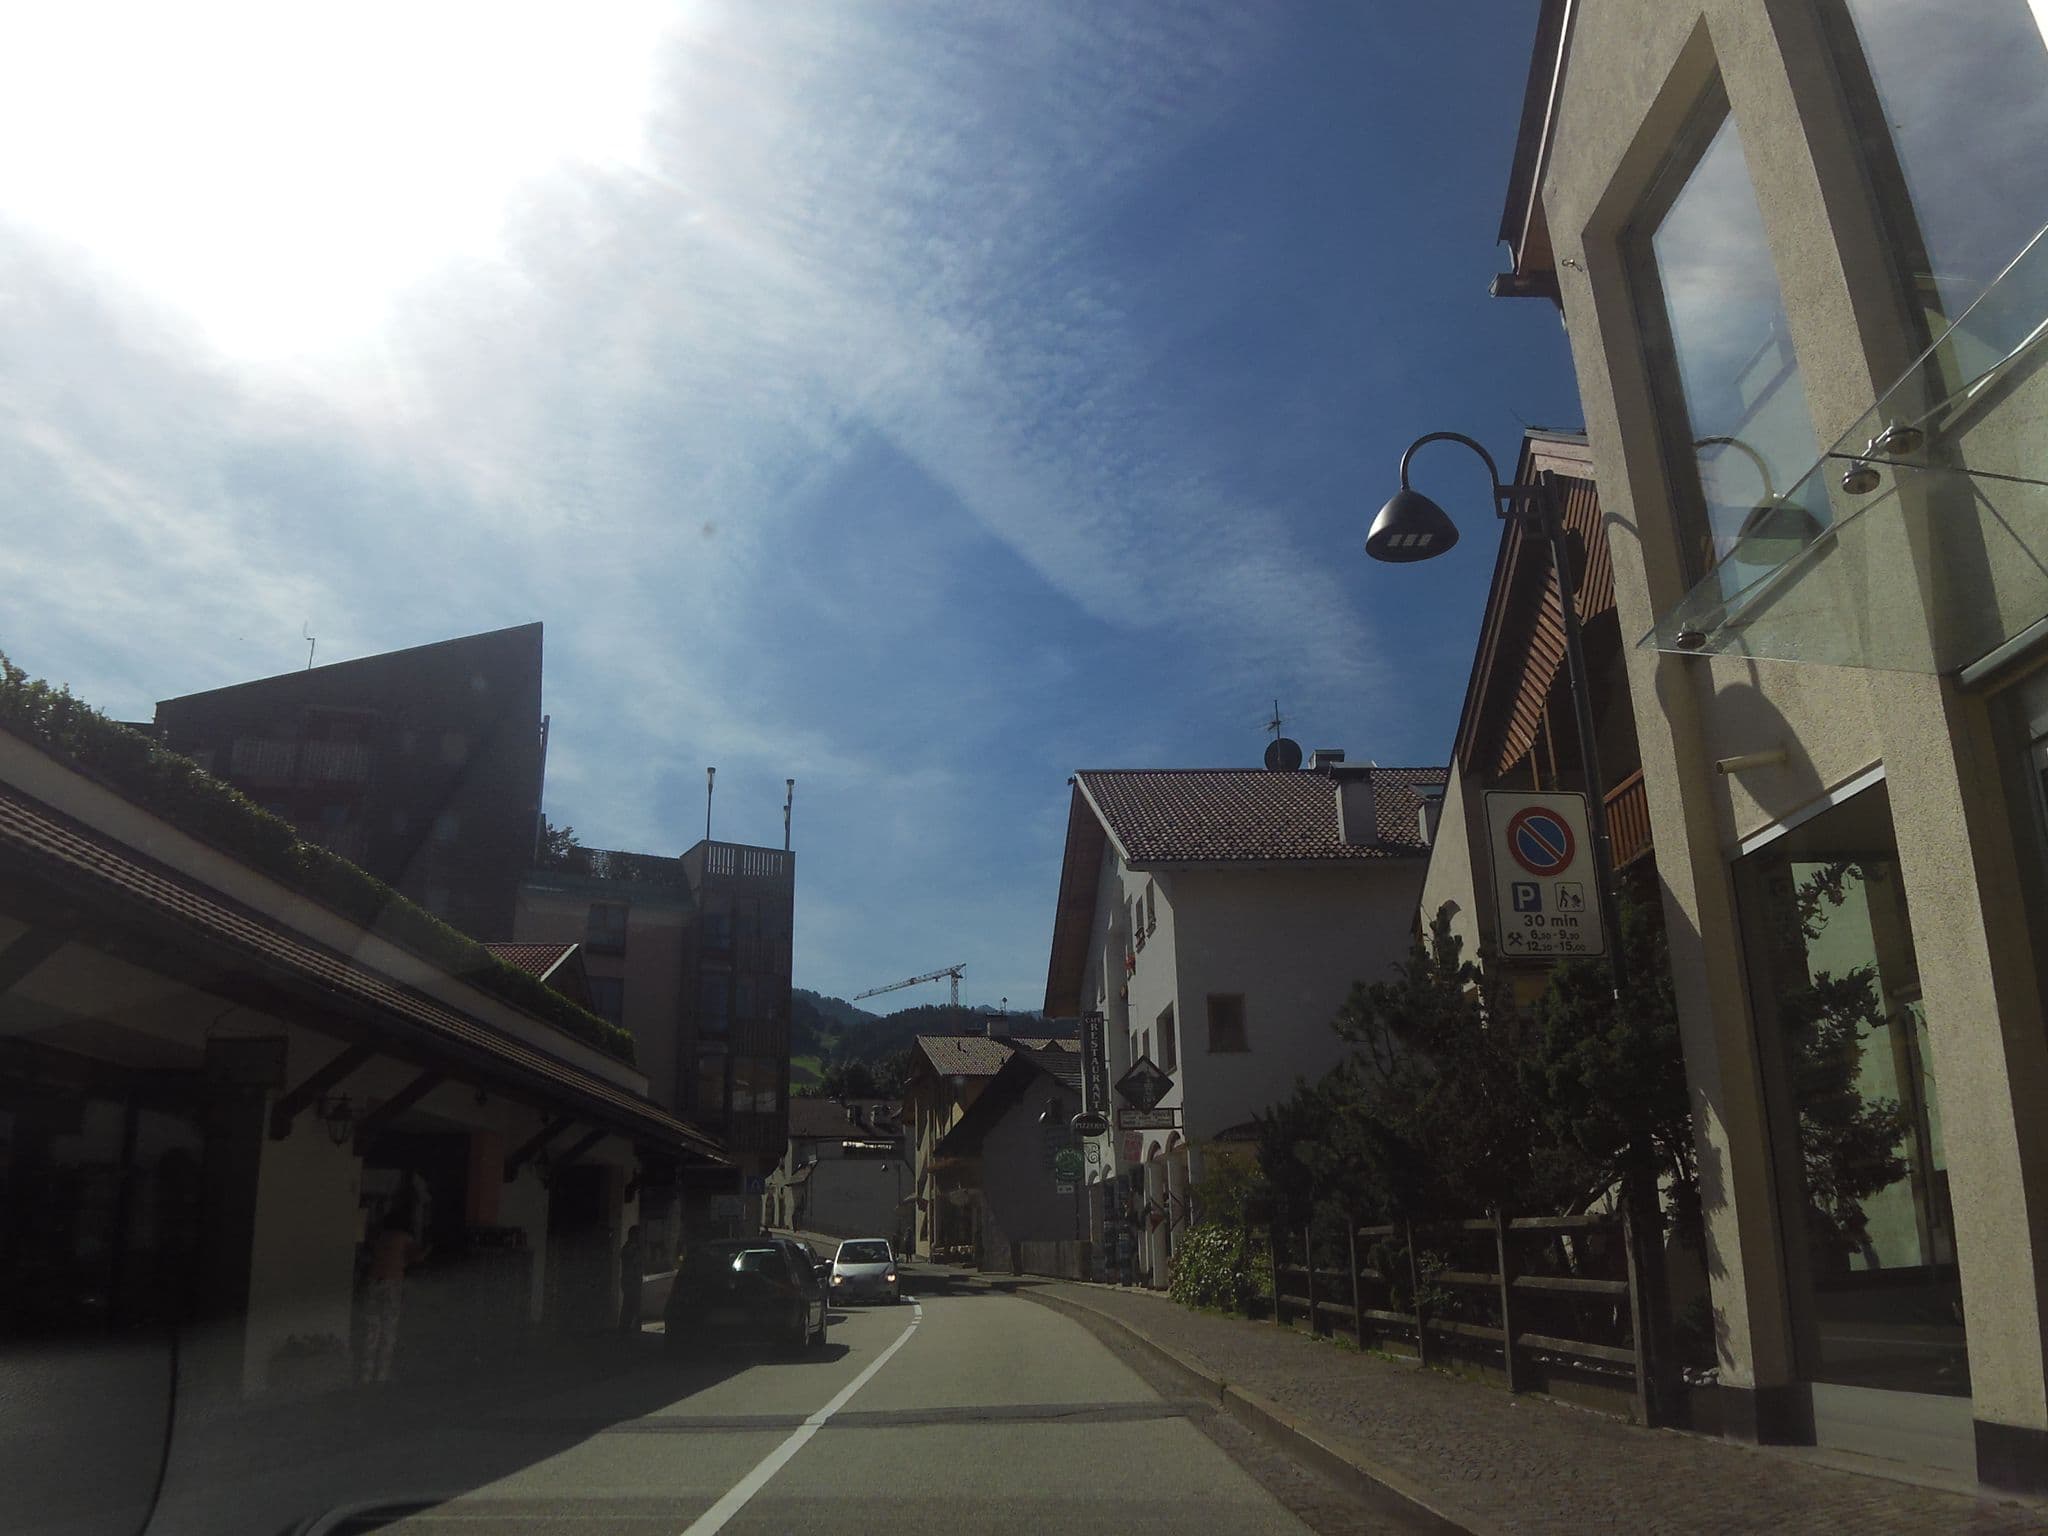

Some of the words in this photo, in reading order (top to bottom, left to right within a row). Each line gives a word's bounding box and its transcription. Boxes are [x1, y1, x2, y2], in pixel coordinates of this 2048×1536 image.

[1517, 884, 1536, 910] P
[1523, 914, 1545, 927] 30
[1551, 914, 1578, 927] min
[1090, 1023, 1102, 1109] RESTAURANT
